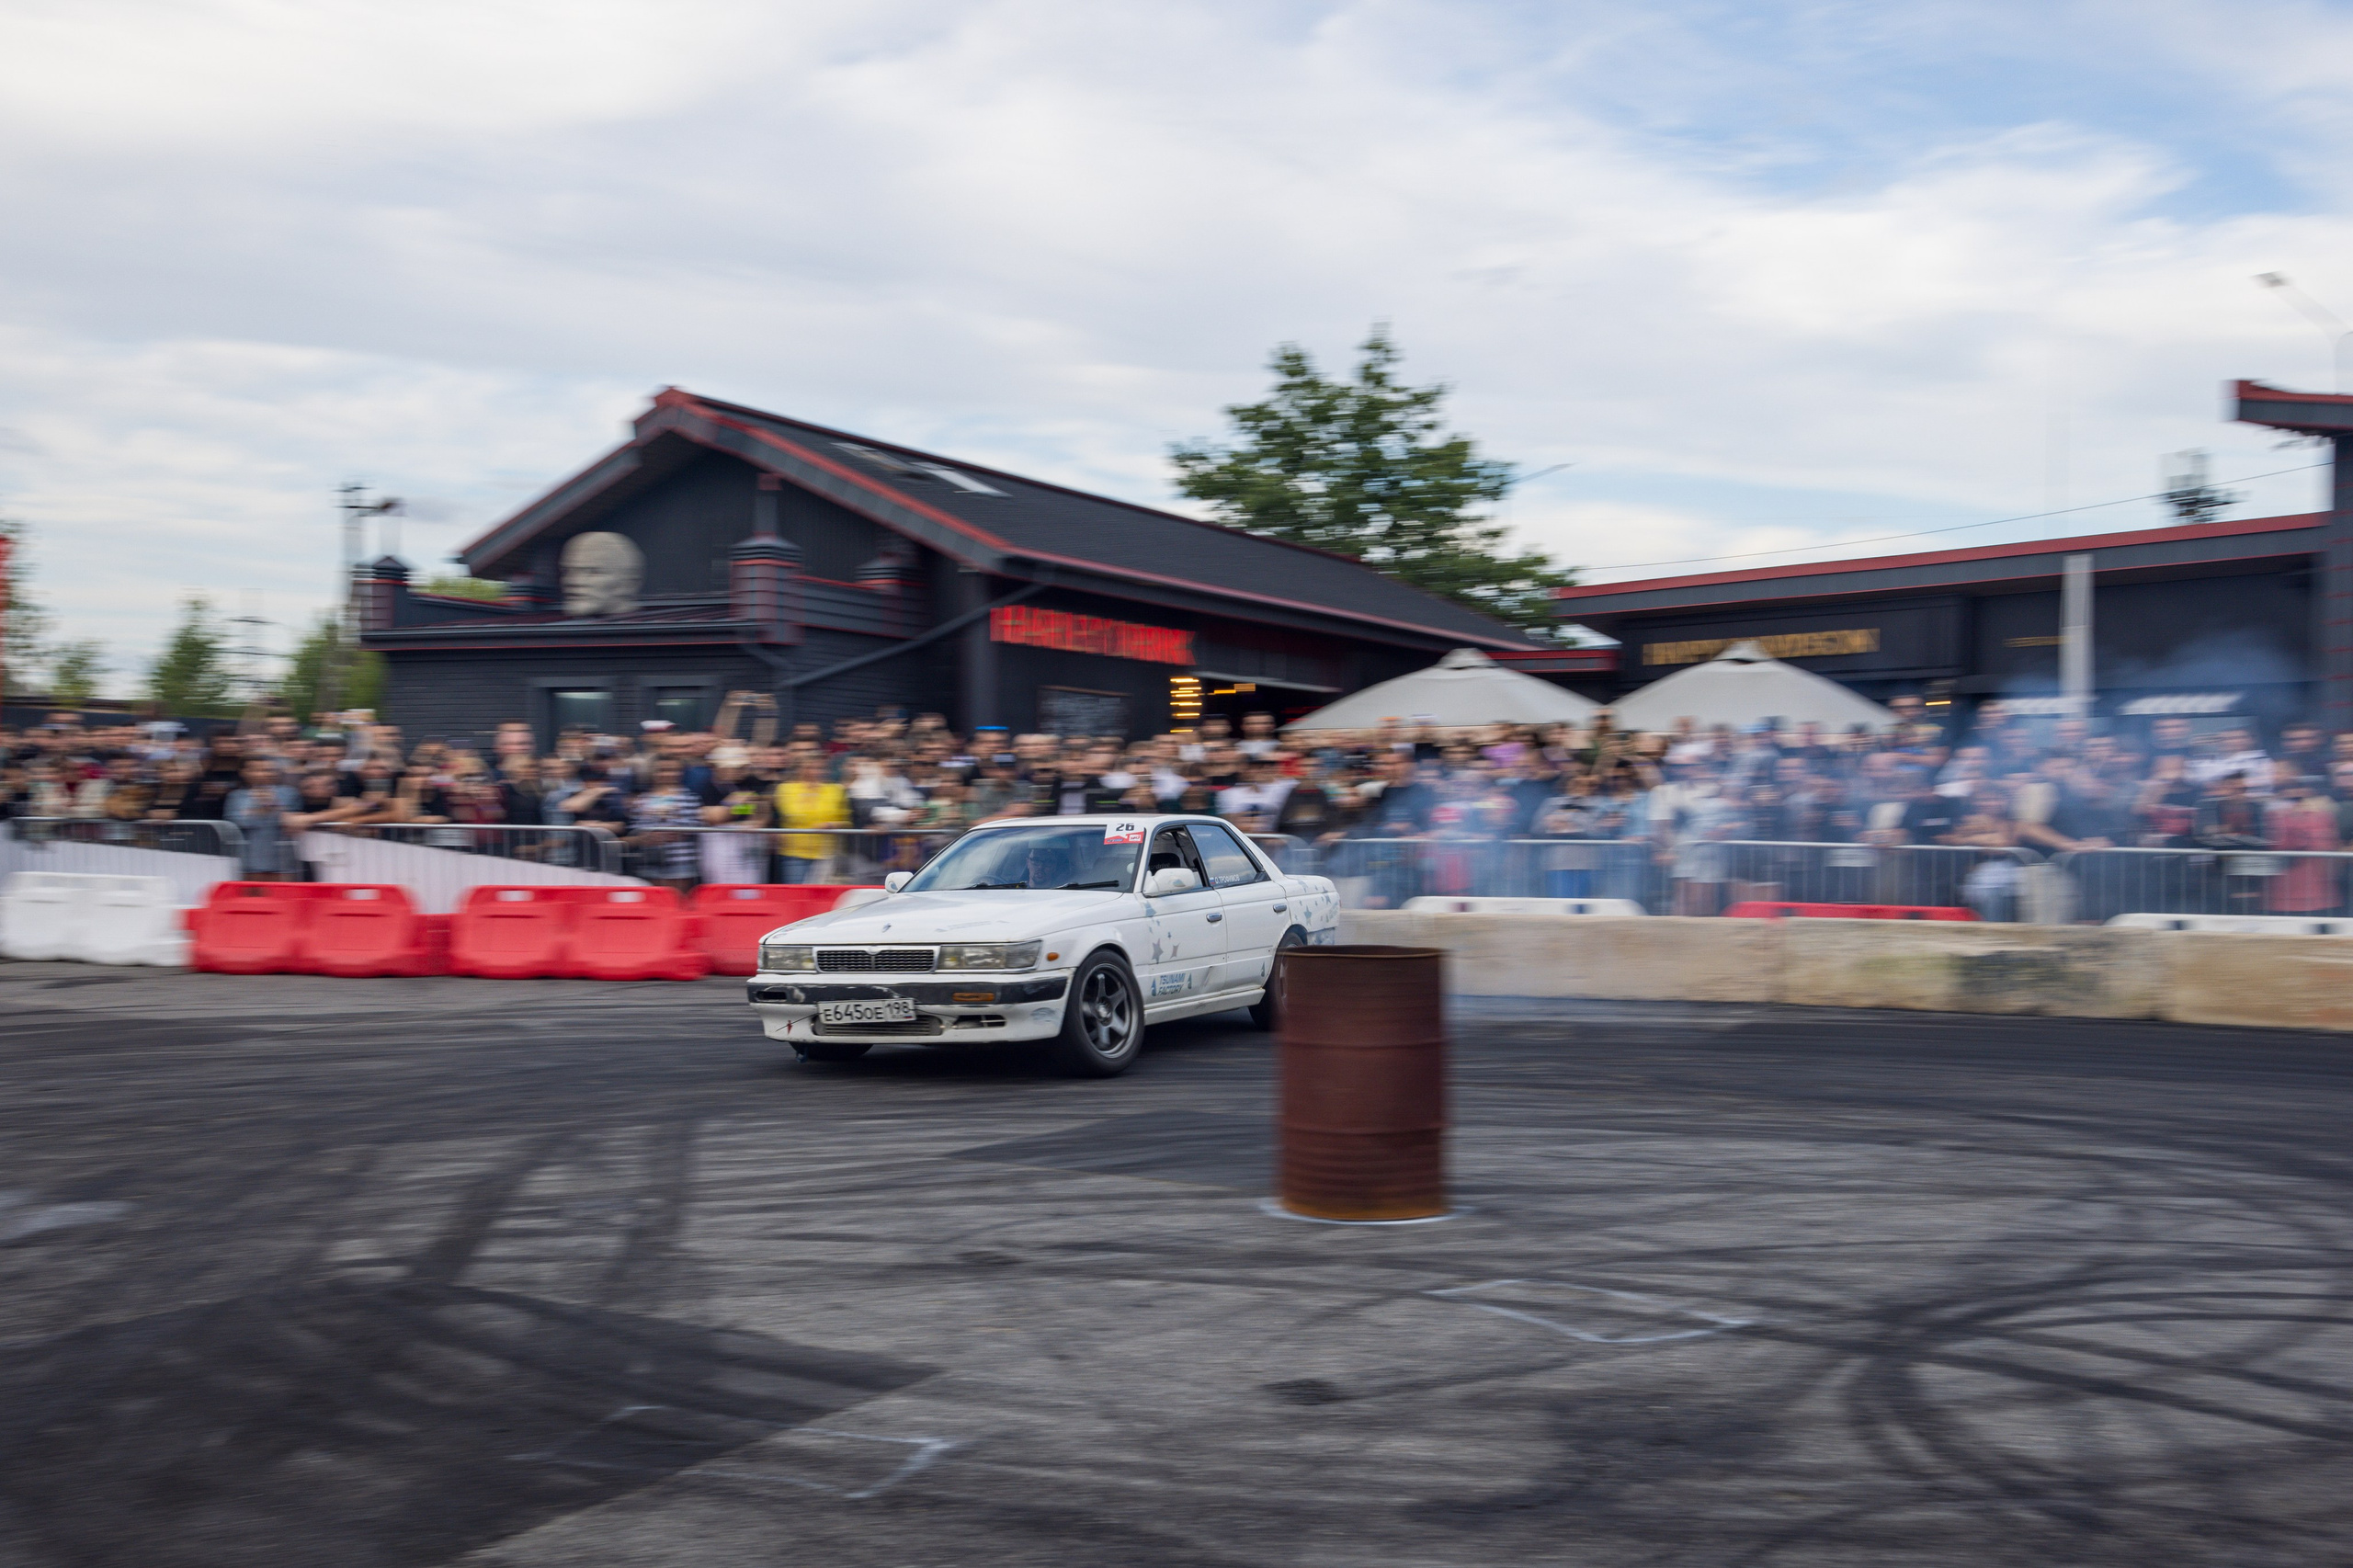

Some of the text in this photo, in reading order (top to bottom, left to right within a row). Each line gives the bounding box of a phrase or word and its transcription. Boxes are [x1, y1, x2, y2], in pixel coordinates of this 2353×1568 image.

[1116, 823, 1135, 832] 26
[1159, 972, 1186, 985] TSUNAMI
[1157, 983, 1184, 995] FACTORY
[885, 1001, 910, 1015] 198
